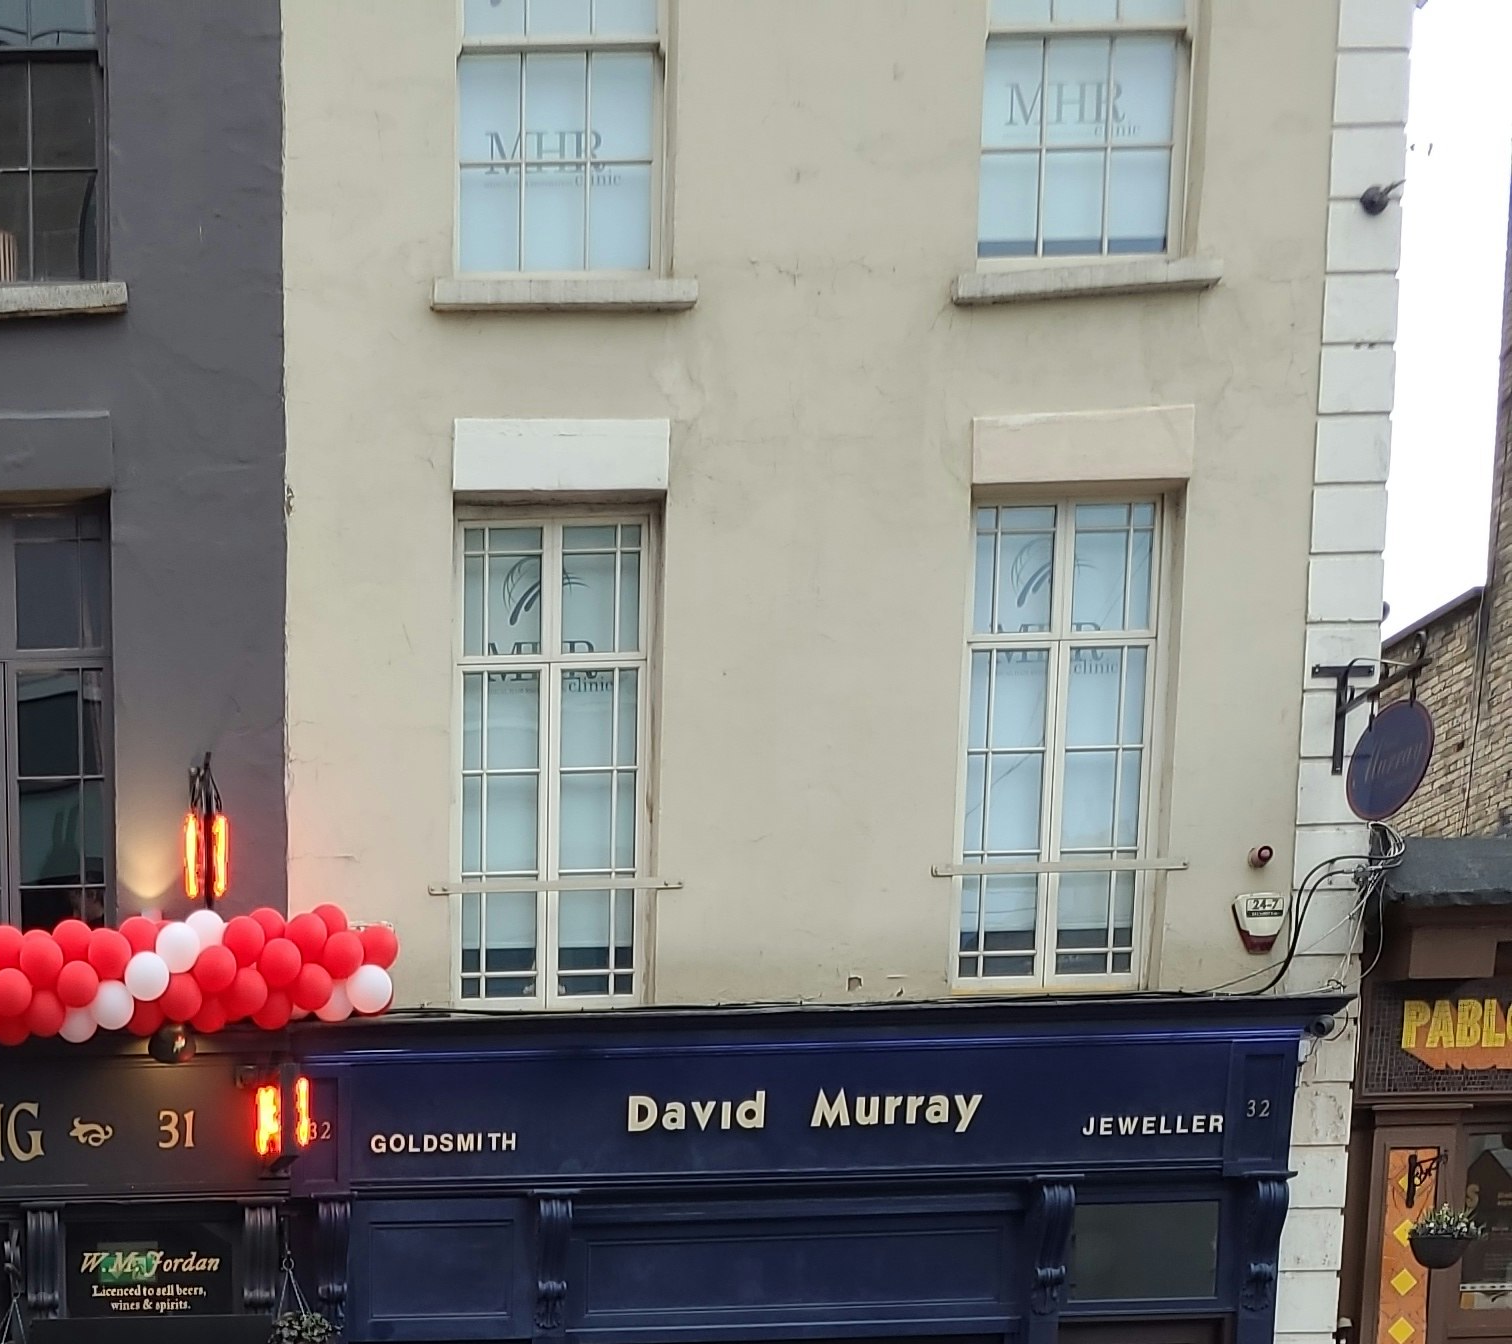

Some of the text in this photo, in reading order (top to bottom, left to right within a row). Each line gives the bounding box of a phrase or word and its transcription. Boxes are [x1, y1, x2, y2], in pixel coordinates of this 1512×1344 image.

[1004, 81, 1126, 126] MHR
[485, 130, 606, 175] MHR
[627, 1087, 984, 1133] David Murray
[1245, 1100, 1271, 1118] 32
[157, 1109, 196, 1149] 31
[1082, 1115, 1224, 1136] JEWELLER
[370, 1131, 518, 1154] GOLDSMITH
[143, 1250, 221, 1278] Jordan
[91, 1285, 142, 1297] Licenced
[143, 1286, 155, 1297] to
[156, 1284, 174, 1296] sell
[110, 1300, 141, 1311] wines
[143, 1298, 152, 1310] &
